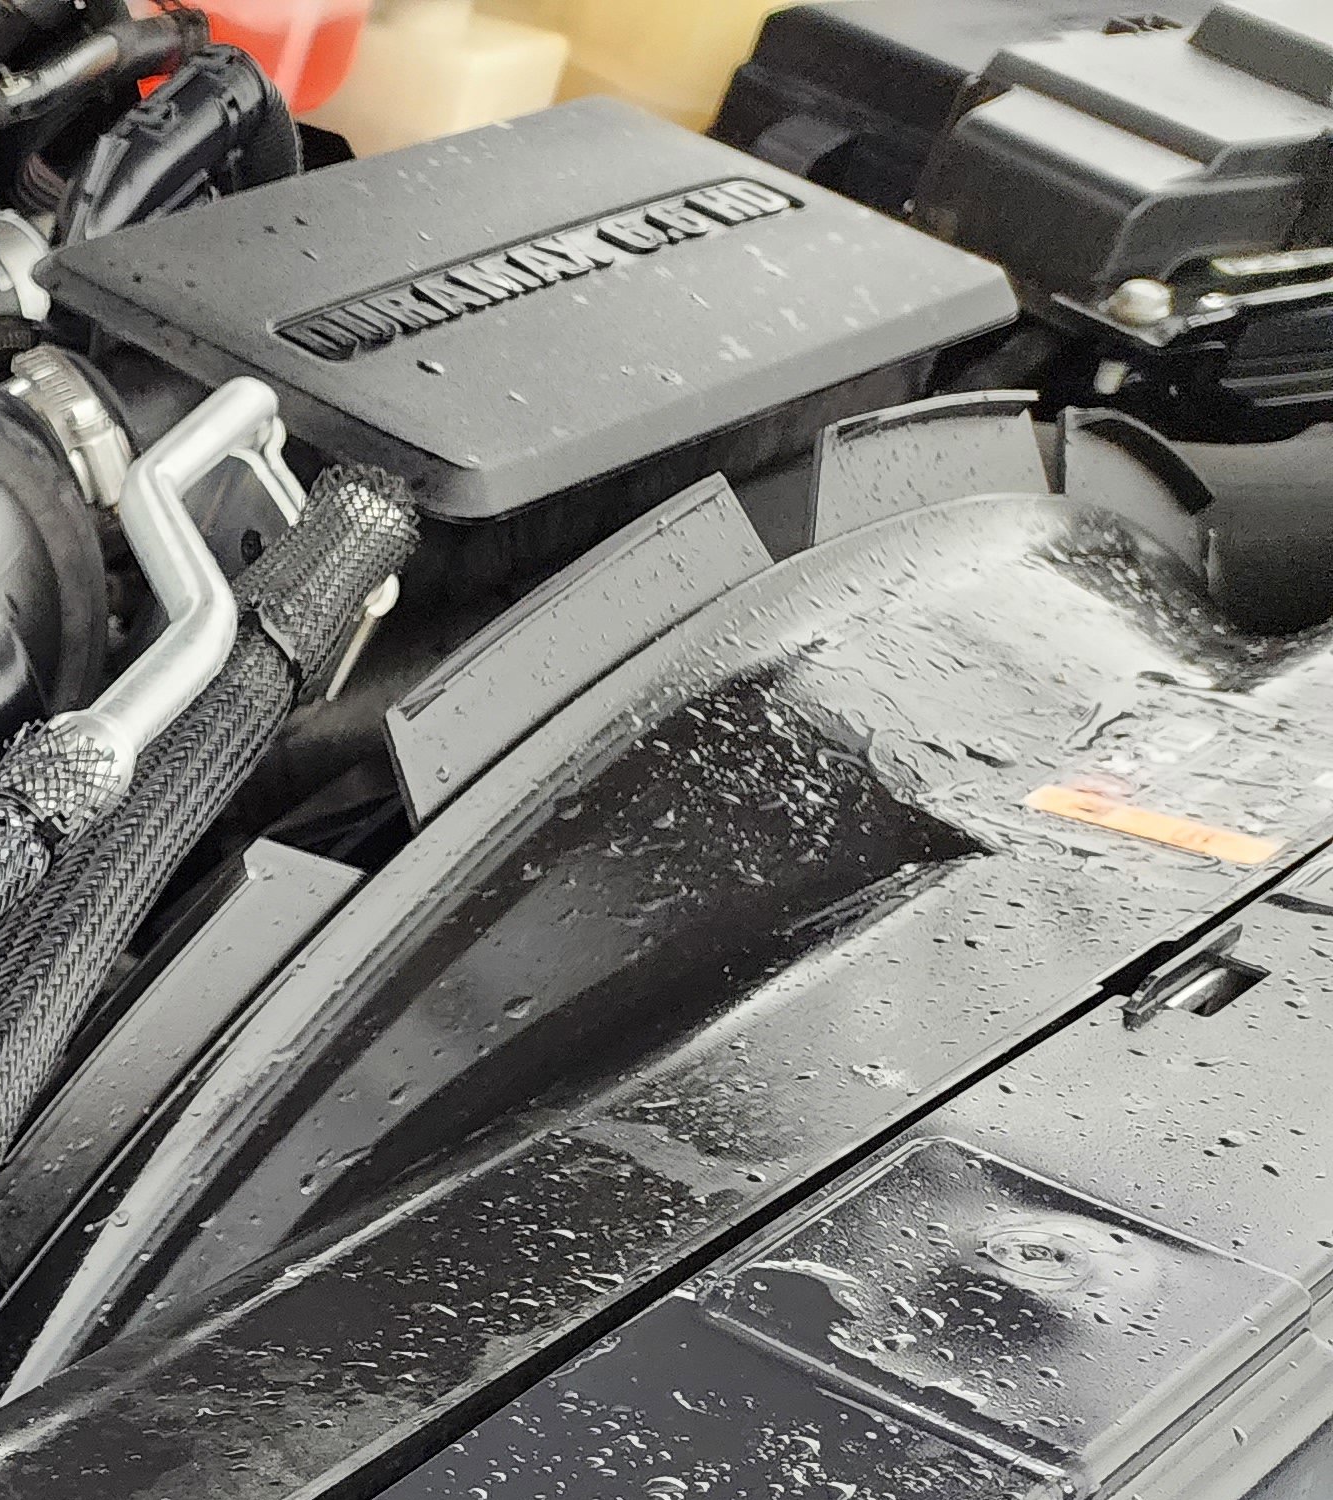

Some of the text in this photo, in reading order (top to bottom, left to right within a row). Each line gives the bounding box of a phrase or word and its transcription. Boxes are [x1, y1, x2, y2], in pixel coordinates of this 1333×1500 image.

[283, 177, 793, 360] DURAMAX 6.6 HD
